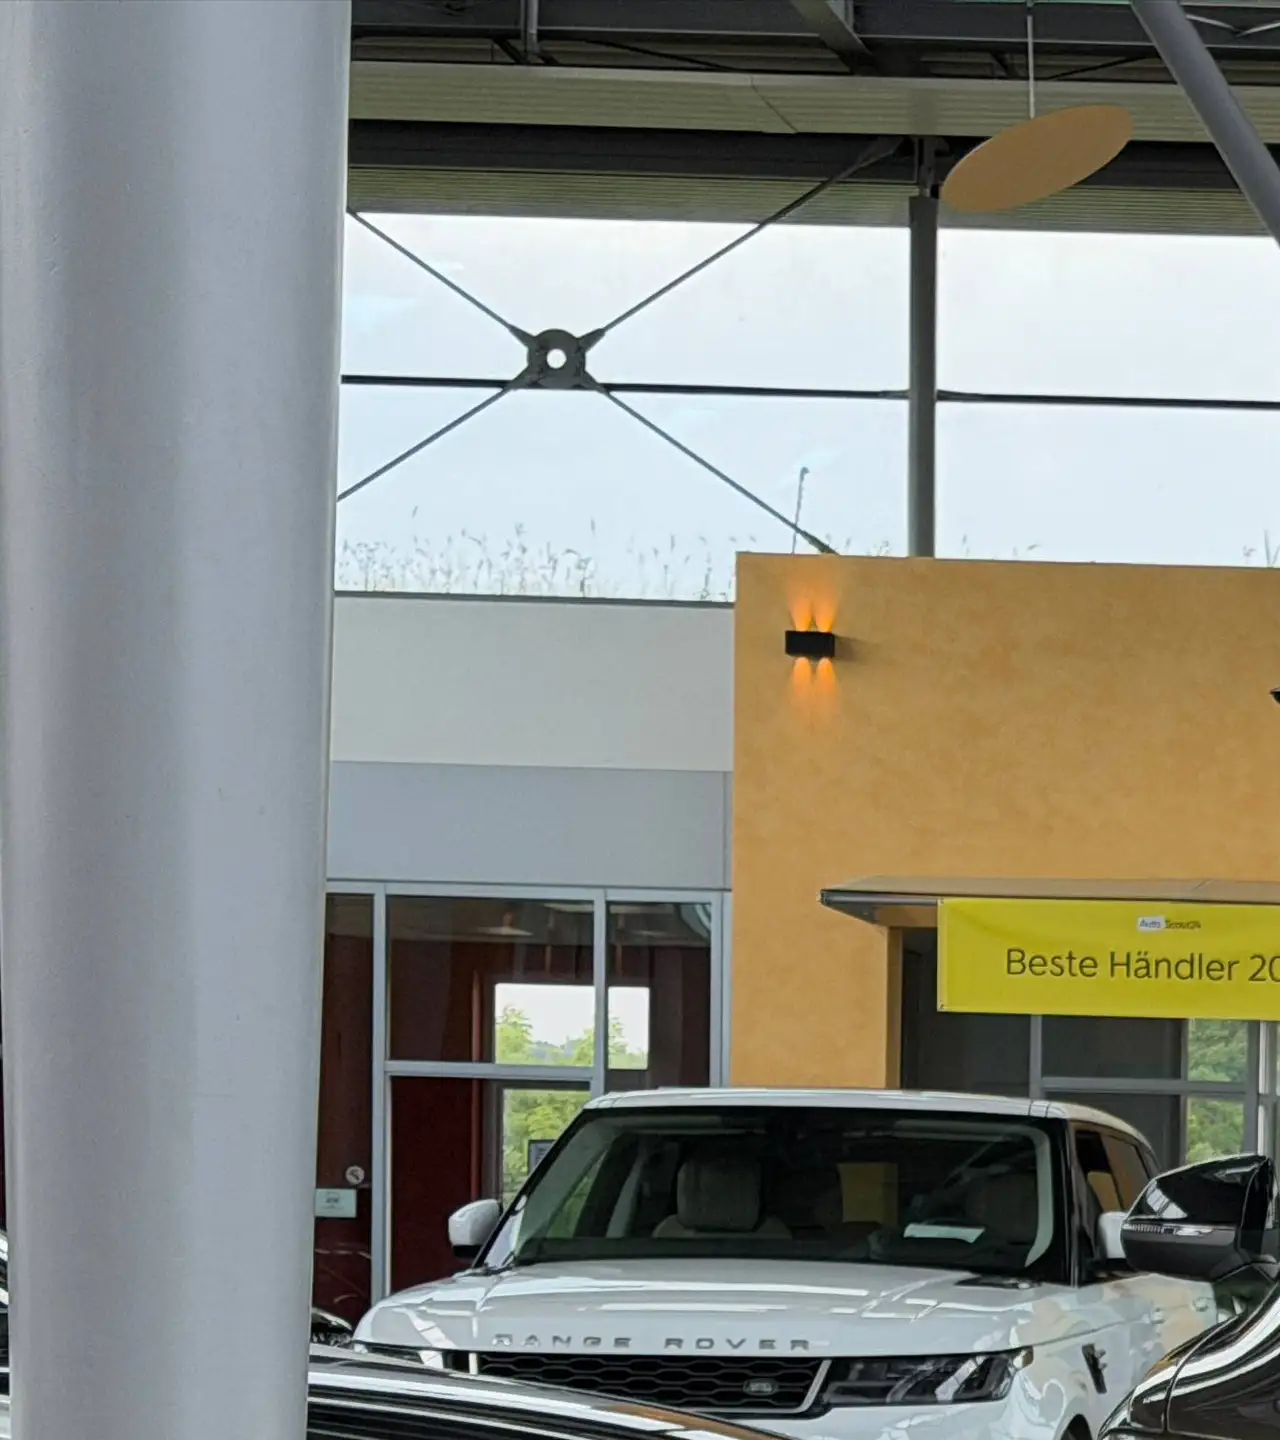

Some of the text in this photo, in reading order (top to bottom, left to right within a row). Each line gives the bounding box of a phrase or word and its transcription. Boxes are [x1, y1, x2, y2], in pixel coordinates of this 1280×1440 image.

[1006, 947, 1099, 977] Beste
[1110, 950, 1240, 981] Händler
[492, 1333, 810, 1350] RANGE ROVER
